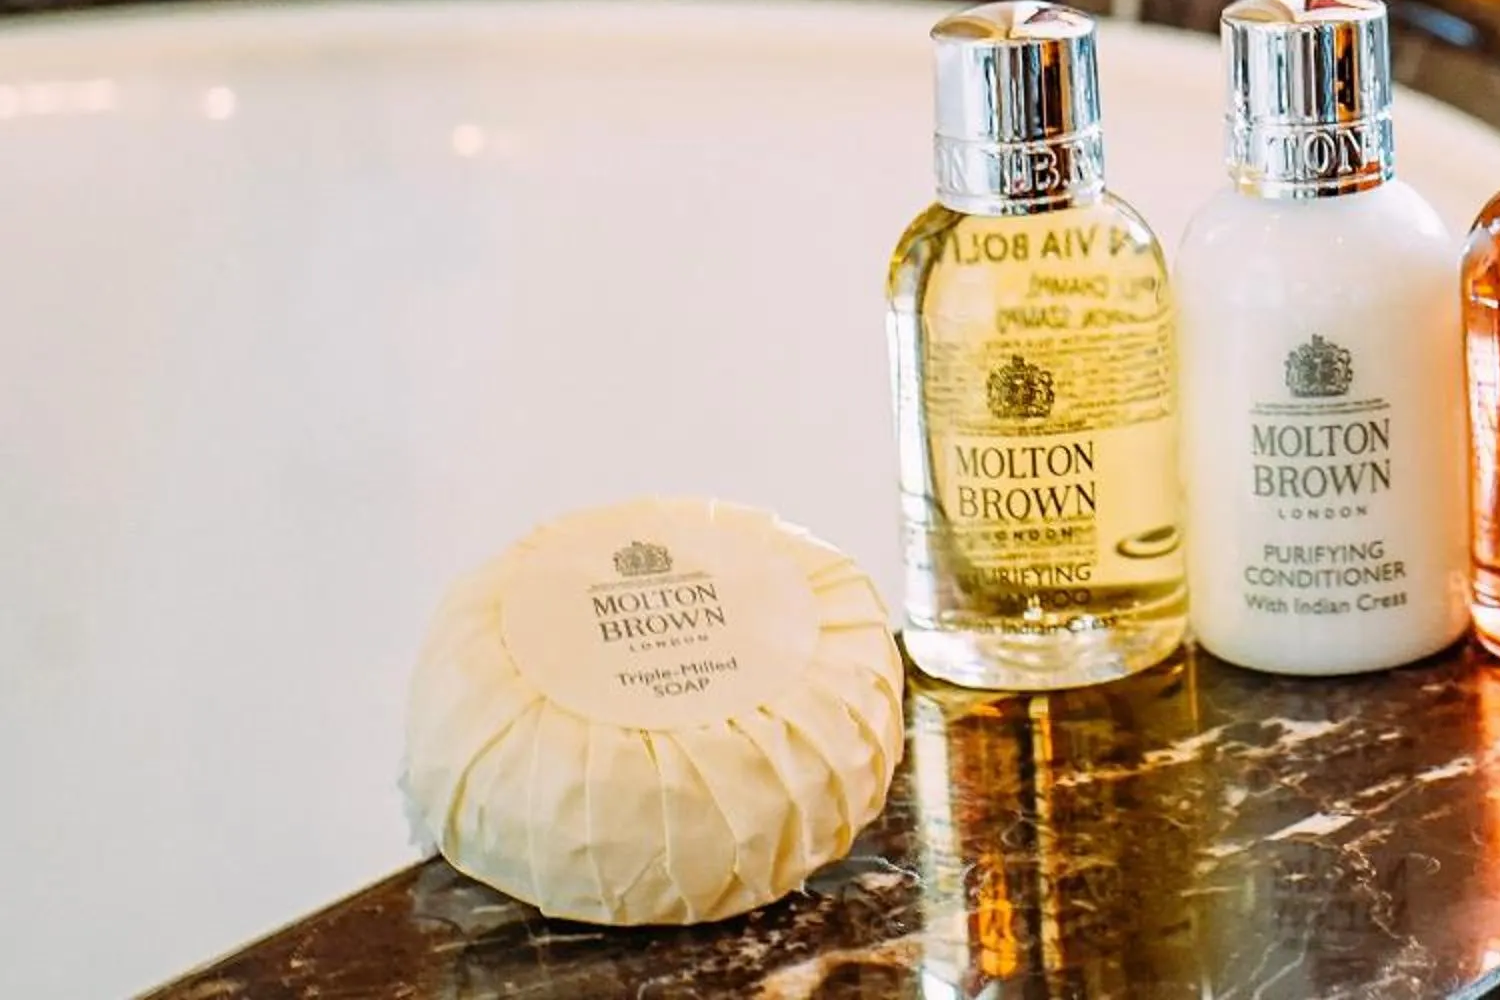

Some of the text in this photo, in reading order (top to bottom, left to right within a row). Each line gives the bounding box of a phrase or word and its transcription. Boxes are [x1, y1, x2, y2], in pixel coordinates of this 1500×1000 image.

[1251, 418, 1390, 457] MOLTON
[955, 441, 1094, 479] MOLTON
[1252, 459, 1391, 498] BROWN
[958, 482, 1096, 520] BROWN
[1278, 505, 1368, 520] LONDON
[1263, 541, 1385, 564] PURIFYING
[1244, 561, 1407, 588] CONDITIONER
[592, 583, 718, 617] MOLTON
[1244, 592, 1408, 616] With Indian Cress
[598, 606, 727, 643] BROWN
[616, 656, 738, 687] Triple-Milled
[652, 677, 710, 698] SOAP
